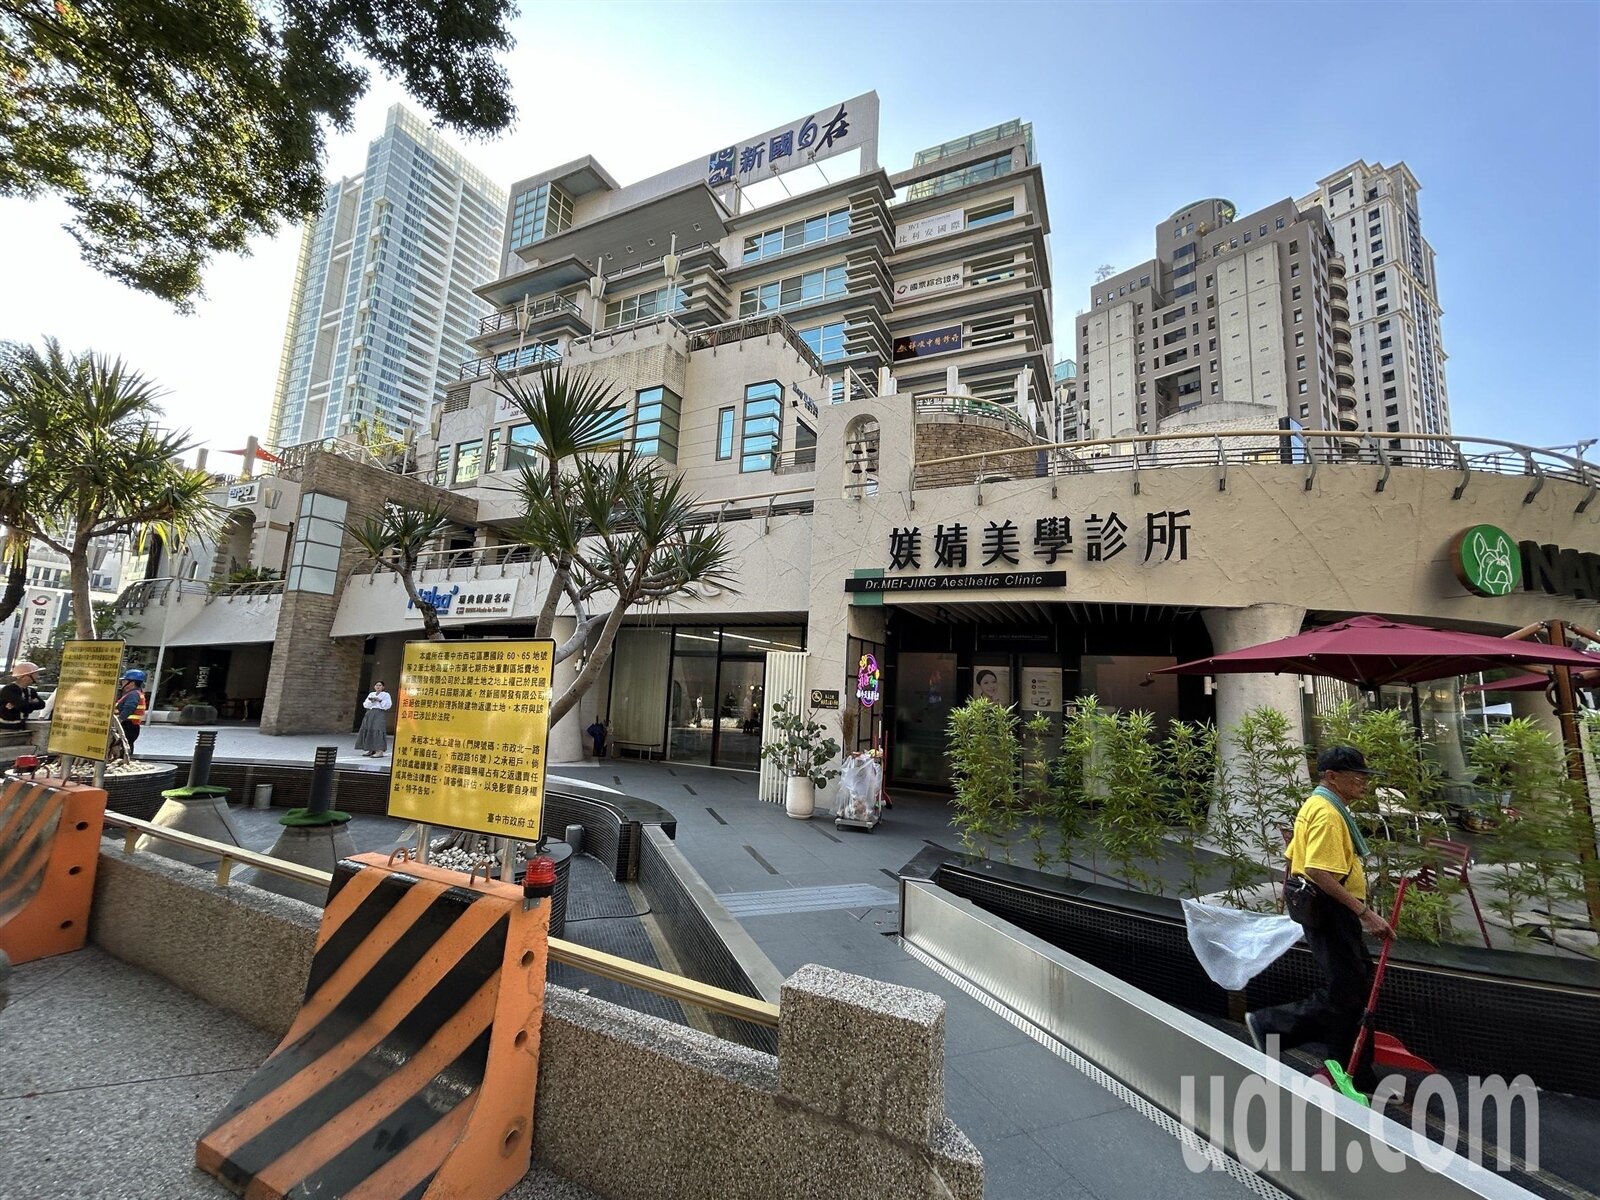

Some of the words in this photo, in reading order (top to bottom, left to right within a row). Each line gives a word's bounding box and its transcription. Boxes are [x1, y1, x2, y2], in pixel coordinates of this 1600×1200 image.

[739, 103, 850, 174] 新國自在
[909, 273, 960, 291] 國票綜合證券
[888, 509, 1191, 570] 媄婧美學診所
[941, 576, 1000, 587] Aesthetic
[1005, 574, 1042, 585] Clinic
[533, 651, 548, 661] 地號
[487, 812, 525, 828] 臺中市政府
[527, 819, 535, 829] 立
